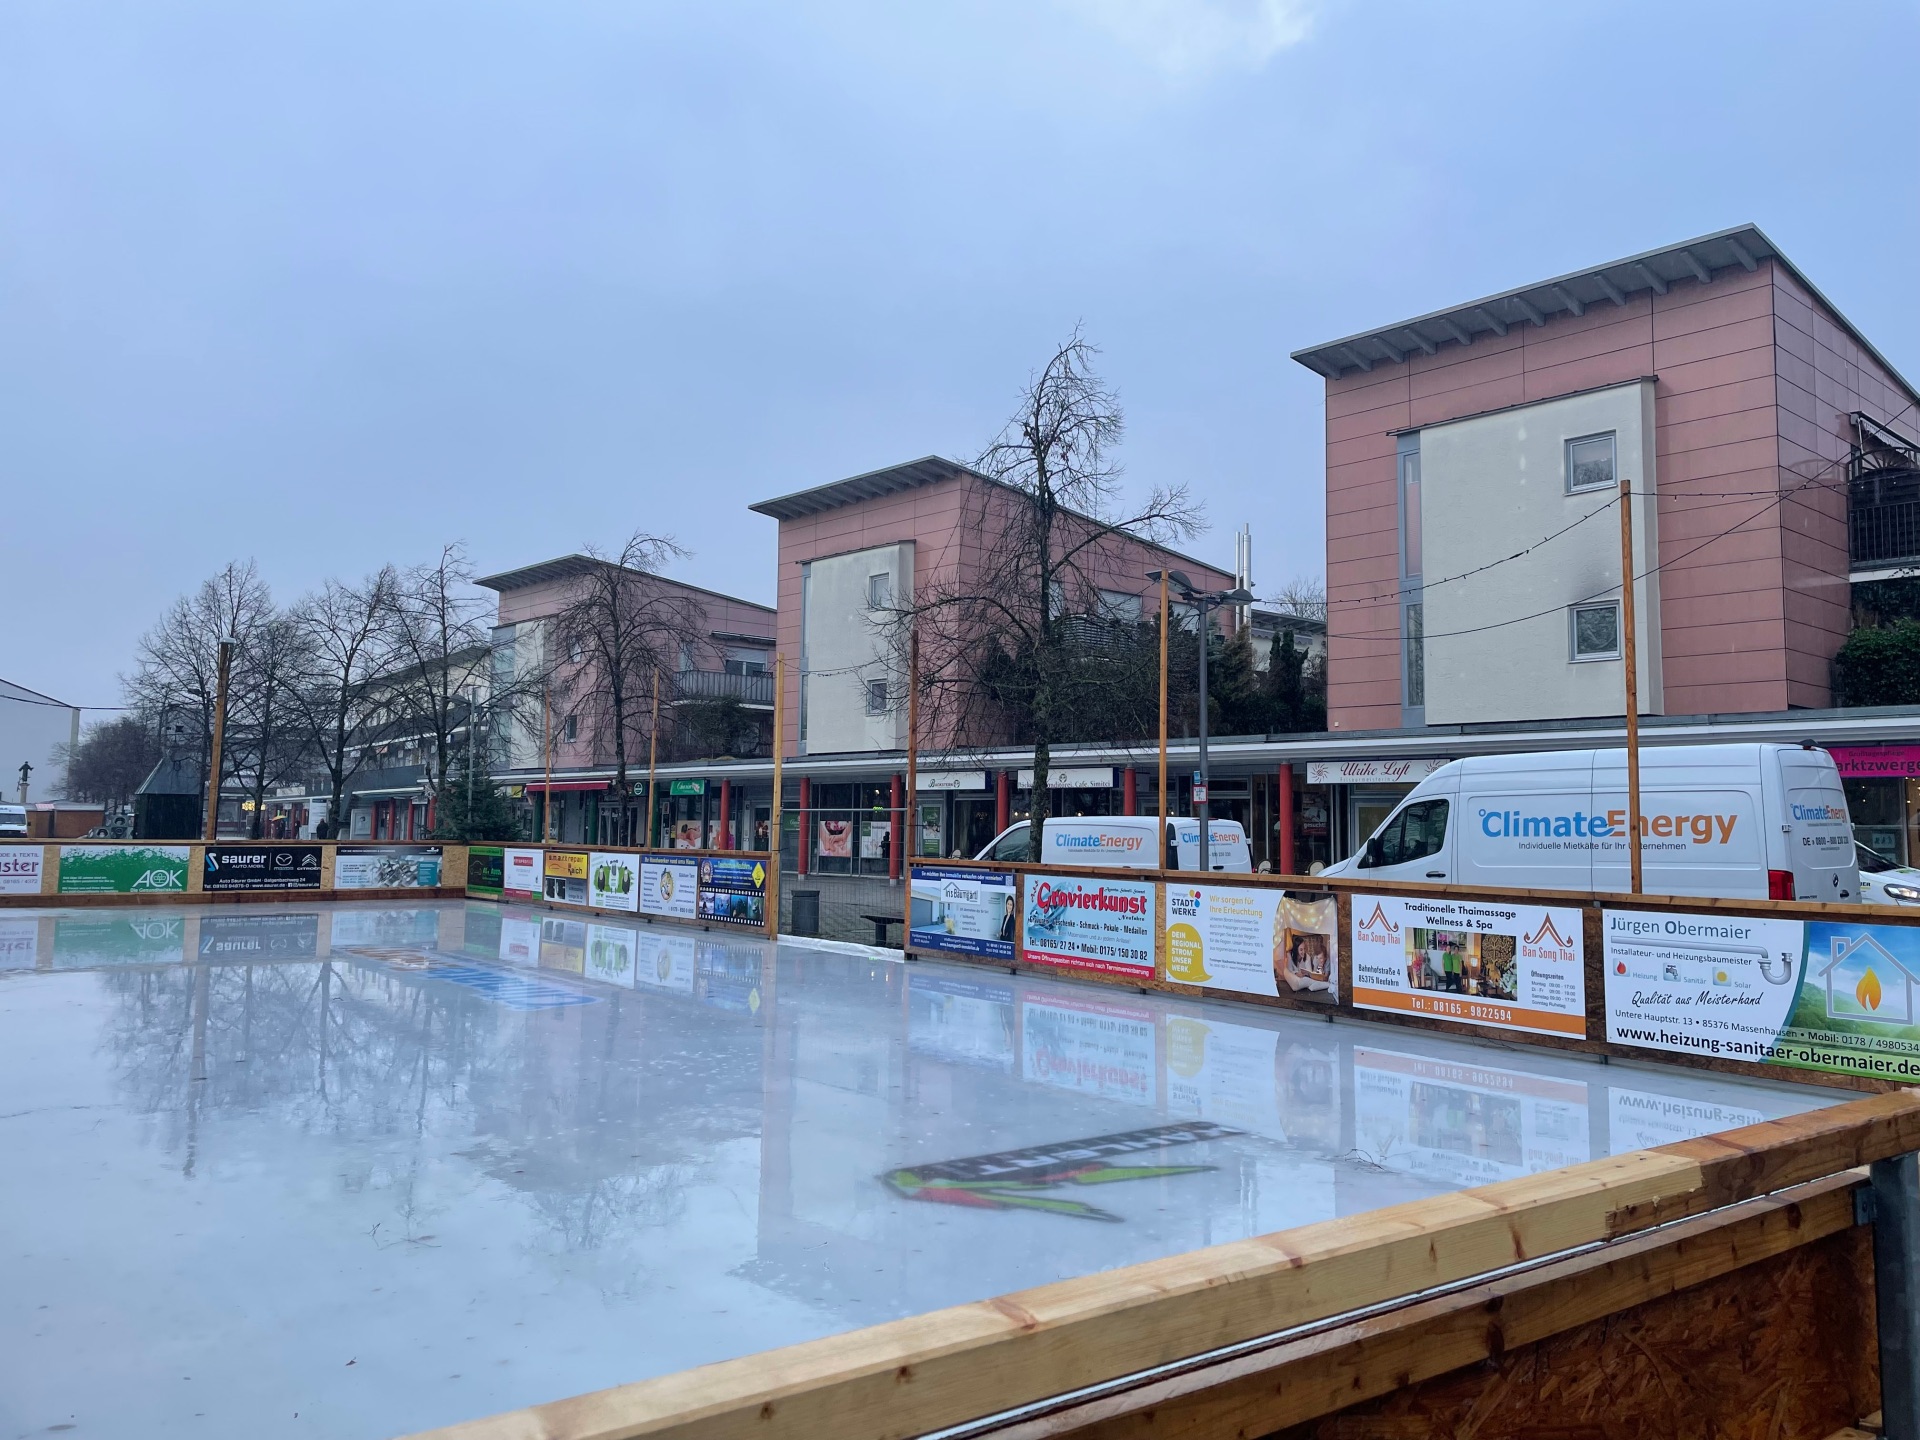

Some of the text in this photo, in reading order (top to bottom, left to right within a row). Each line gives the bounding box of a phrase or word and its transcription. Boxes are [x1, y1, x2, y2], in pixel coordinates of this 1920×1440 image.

[1340, 761, 1412, 781] Ulrike Luft
[1836, 759, 1920, 773] arktzwerg
[1518, 842, 1561, 850] Individuelle
[1563, 842, 1600, 850] Mietkälte
[1601, 842, 1612, 850] für
[1614, 842, 1626, 850] Ihr
[222, 855, 267, 864] saurer
[132, 870, 184, 888] AOK
[1037, 882, 1148, 915] Gravierkunst
[1172, 898, 1194, 907] STADT
[1220, 898, 1244, 906] sorgen
[1244, 897, 1254, 905] für
[1172, 907, 1196, 916] WERKE
[1210, 906, 1263, 918] Ihre Erleuchtung
[1404, 902, 1516, 920] Traditionelle Thaimassage
[1080, 922, 1100, 930] Schmuck
[1426, 916, 1493, 931] Wellness & Spa
[1610, 917, 1752, 940] Jürgen Obermaier
[1172, 940, 1202, 950] REGIONAL
[1358, 930, 1400, 945] Ban Song Thai
[1060, 940, 1067, 950] 27
[1068, 942, 1075, 950] 24
[1081, 944, 1098, 954] Mobil:
[1118, 947, 1129, 958] 150
[1130, 950, 1138, 959] 30
[1140, 950, 1148, 960] 82
[1522, 946, 1575, 963] Ban Song Thai
[1610, 947, 1752, 966] Installateur- und Heizungsbaumeister
[1172, 956, 1192, 964] UNSER
[1358, 964, 1396, 976] Bahnhofstraße
[1375, 975, 1400, 987] Neufahrn
[1632, 972, 1658, 981] Heizung
[1684, 976, 1707, 985] Sanitär
[1632, 990, 1764, 1007] Qualität aus Meisterhand
[1412, 998, 1512, 1021] Tel.: 08165 9822594
[1615, 1010, 1642, 1019] Untere
[1644, 1013, 1680, 1024] Hauptstr.
[1702, 1020, 1729, 1030] 85376
[1731, 1023, 1797, 1037] Massenhausen
[1808, 1031, 1839, 1043] Mobil:
[1842, 1035, 1866, 1046] 0178
[1875, 1040, 1919, 1052] 4980534
[1616, 1028, 1920, 1075] www.heizung-sanitaer-obermaier.de
